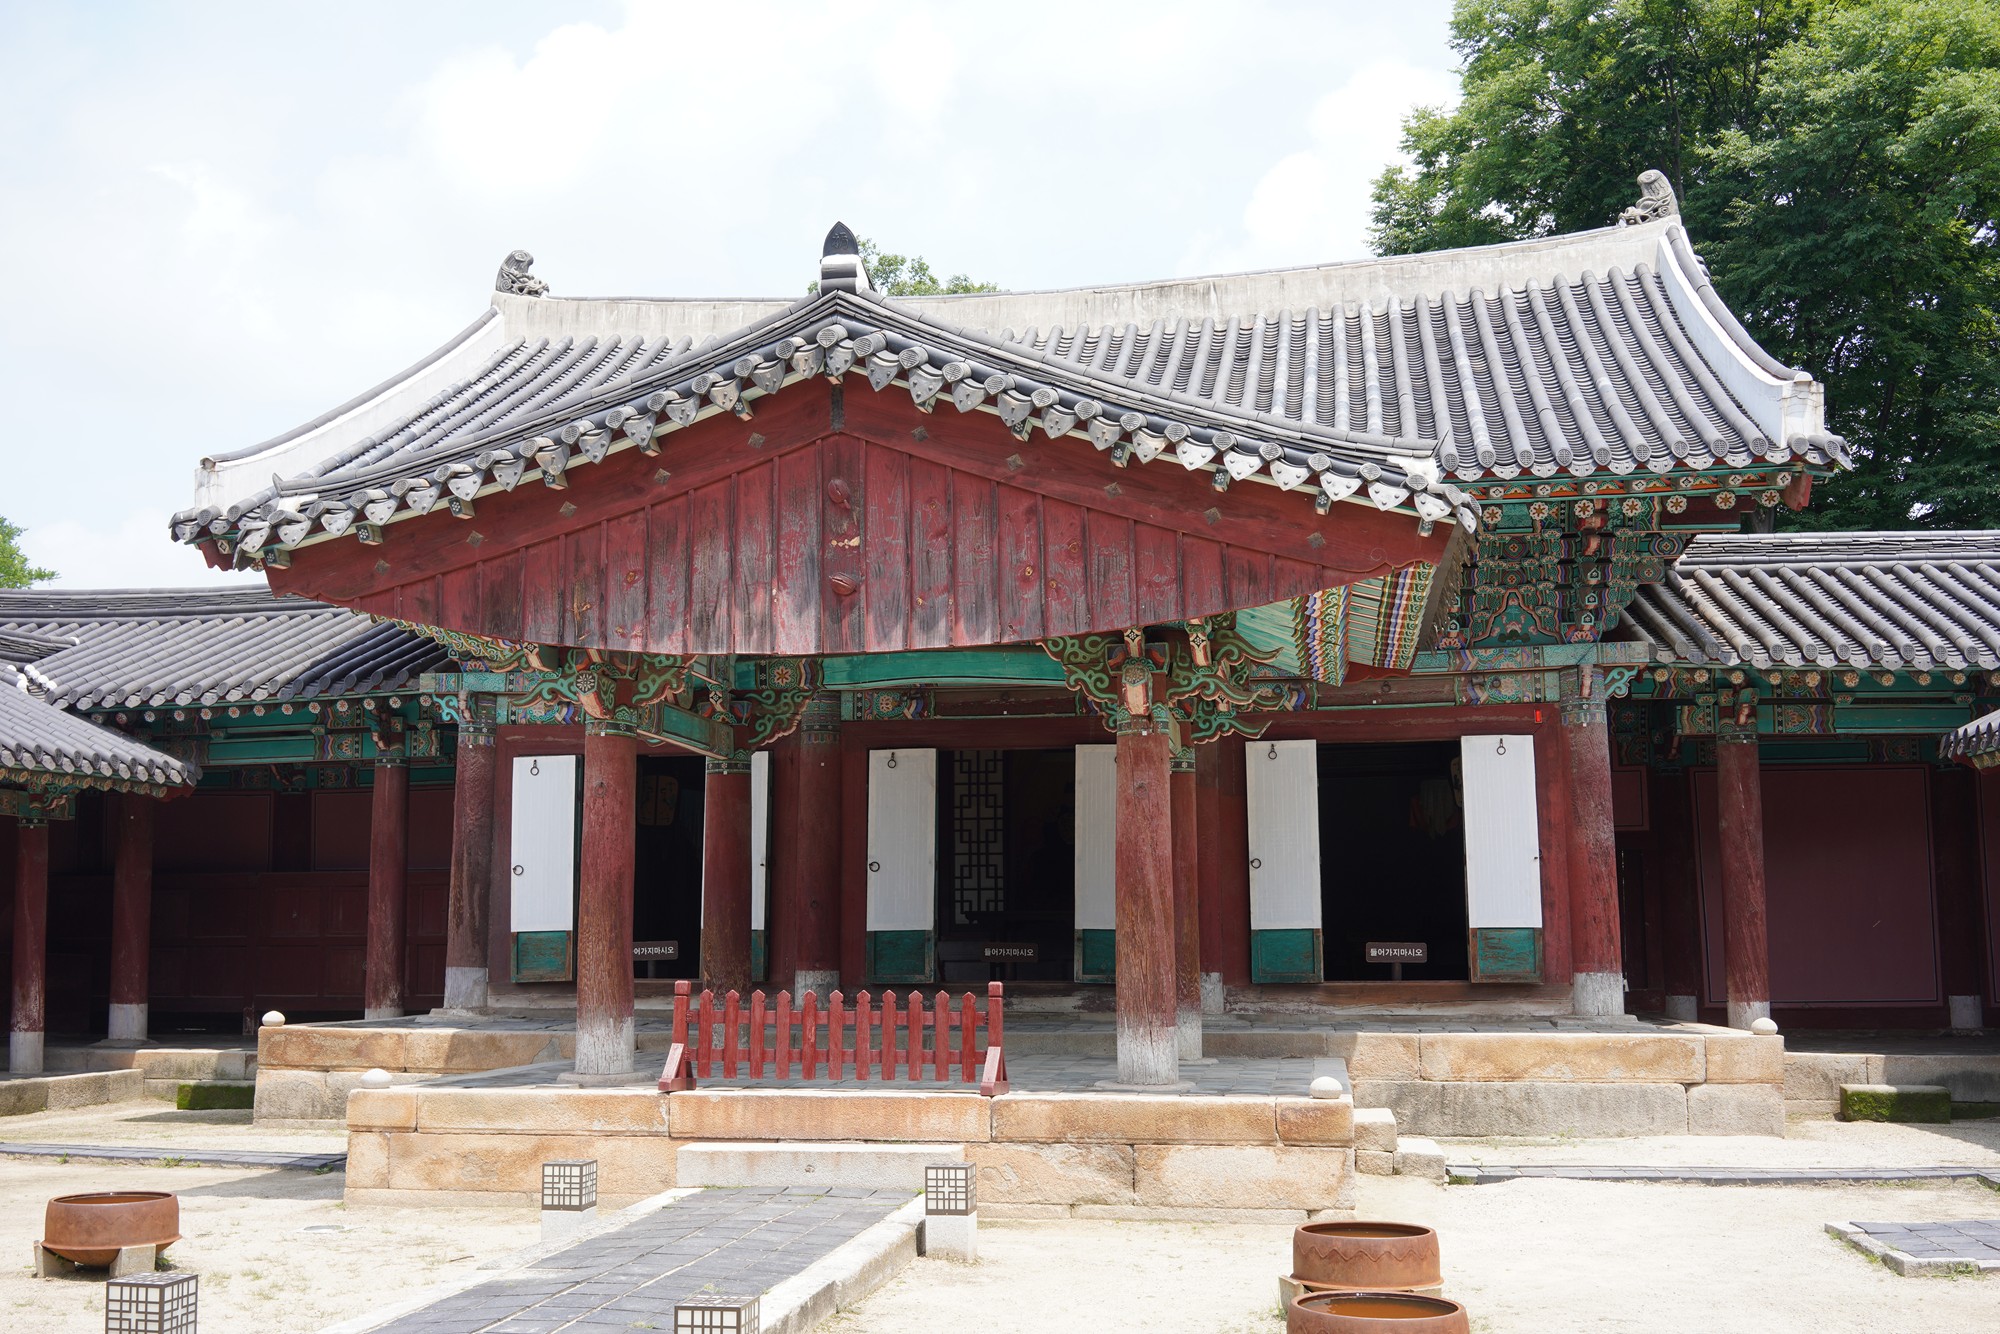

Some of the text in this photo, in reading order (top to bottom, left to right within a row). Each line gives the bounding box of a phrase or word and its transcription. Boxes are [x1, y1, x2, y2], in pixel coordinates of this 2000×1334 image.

[633, 946, 674, 955] 어가지마시오
[984, 947, 1034, 957] 들어가지마시오
[1370, 948, 1423, 957] 들어가지마시오
